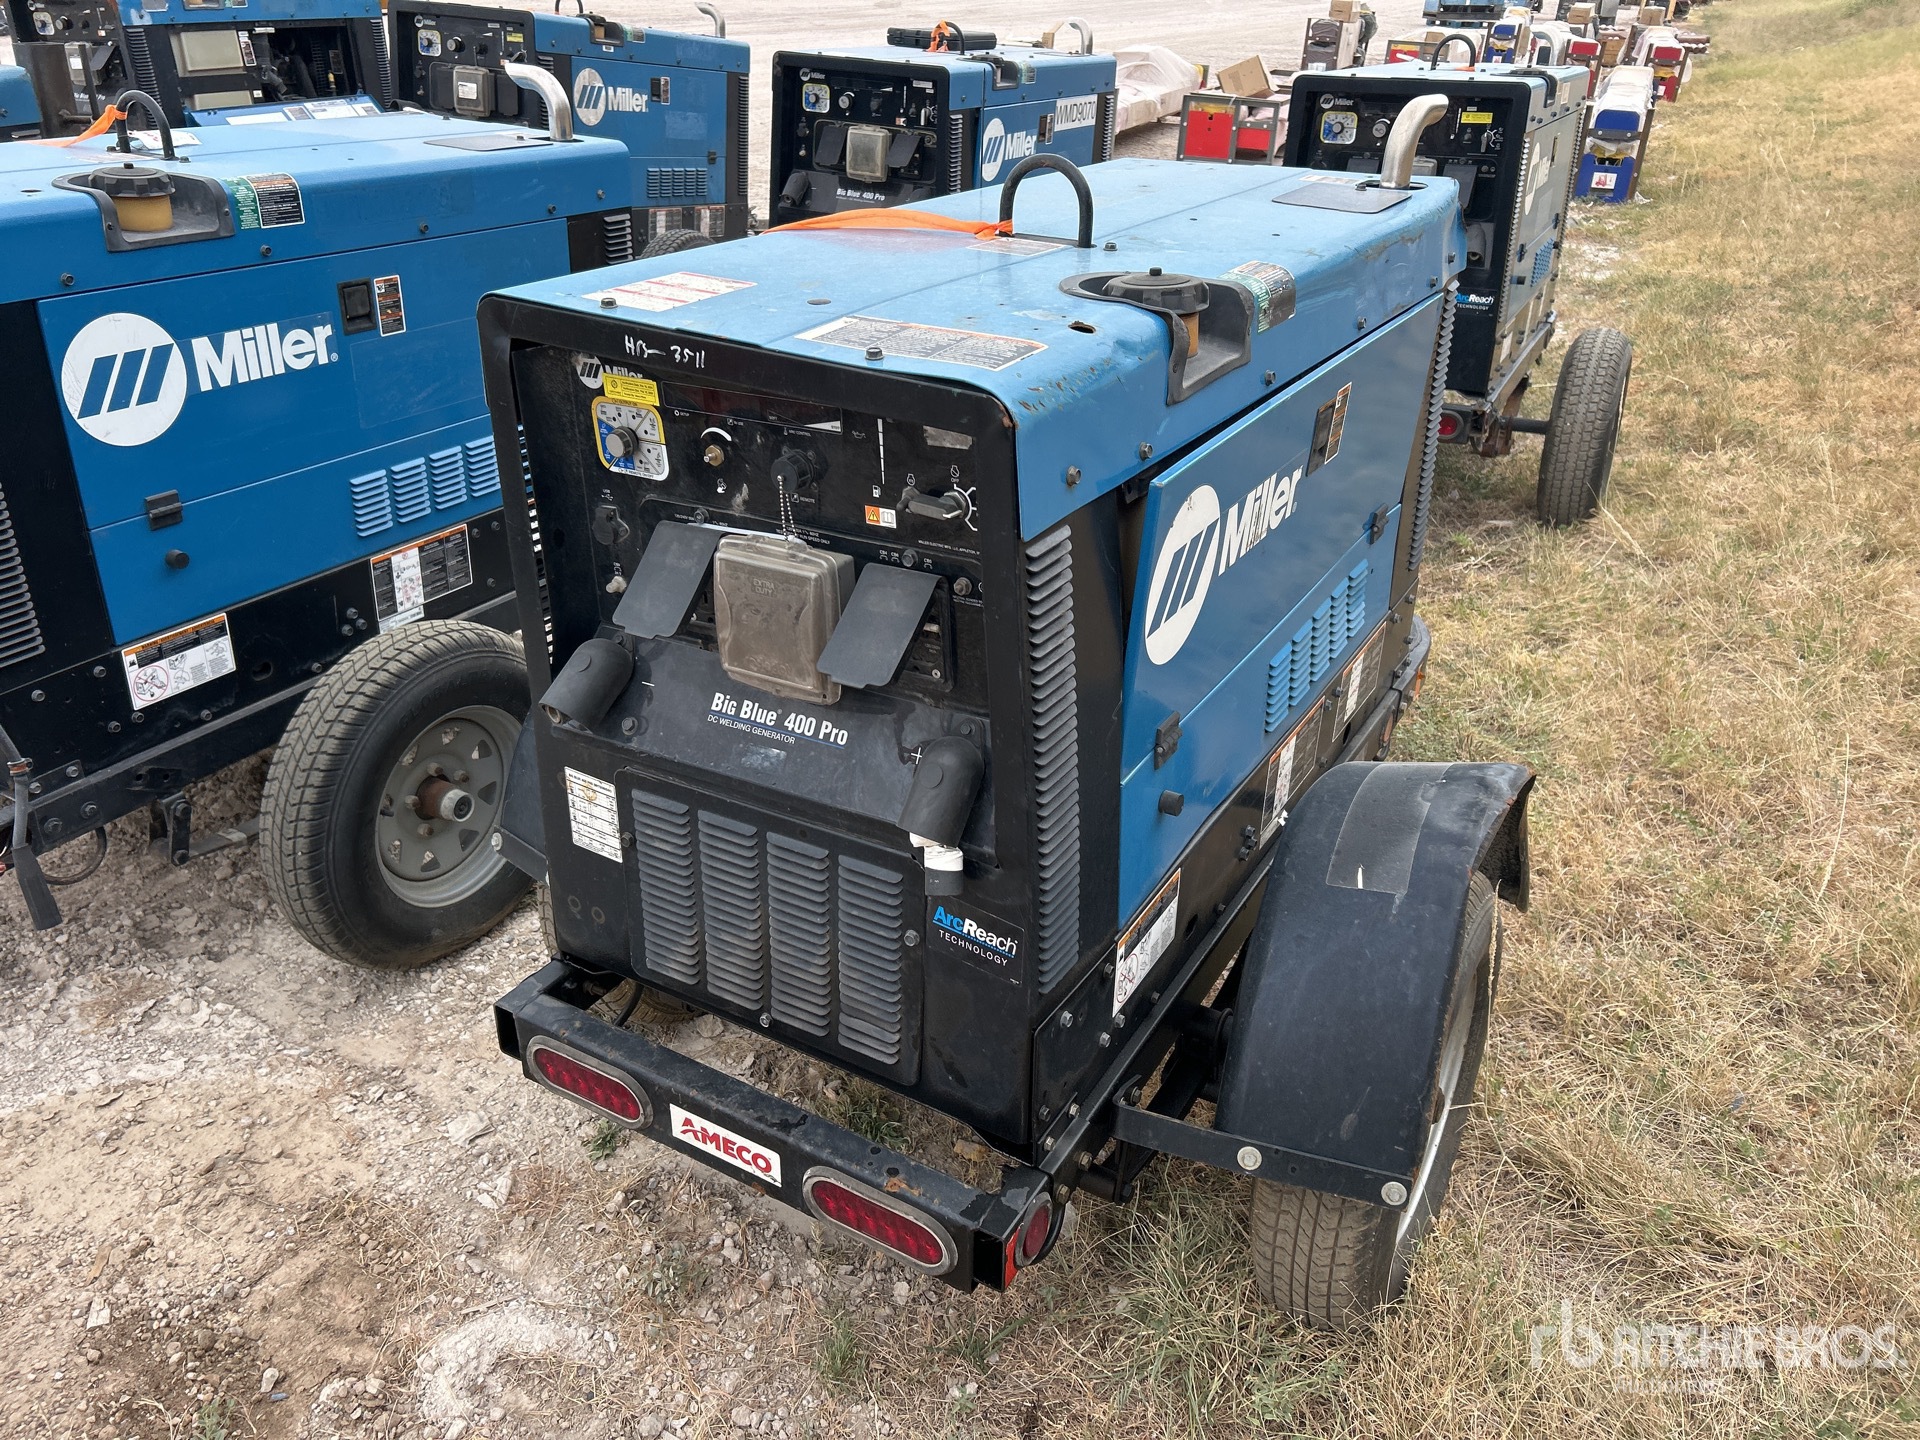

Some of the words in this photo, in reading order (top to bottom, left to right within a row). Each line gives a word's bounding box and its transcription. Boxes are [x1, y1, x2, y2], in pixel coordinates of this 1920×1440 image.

[608, 86, 648, 113] Miller
[1056, 101, 1096, 125] WMD9070
[1334, 97, 1354, 106] Miller
[1005, 130, 1037, 162] Miller
[874, 193, 886, 201] Pro
[1455, 293, 1495, 305] ArcReach
[191, 323, 338, 392] Miller
[670, 345, 705, 368] 3511
[1218, 464, 1304, 576] Miller
[707, 714, 719, 723] DC
[718, 718, 752, 732] WELDING
[751, 726, 796, 745] GENERATOR
[739, 699, 779, 727] Blue
[783, 712, 816, 737] 400
[818, 720, 849, 746] Pro
[932, 905, 1018, 955] ArcReach
[938, 929, 1008, 967] TECHNOLOGY
[680, 1117, 772, 1174] AMECO
